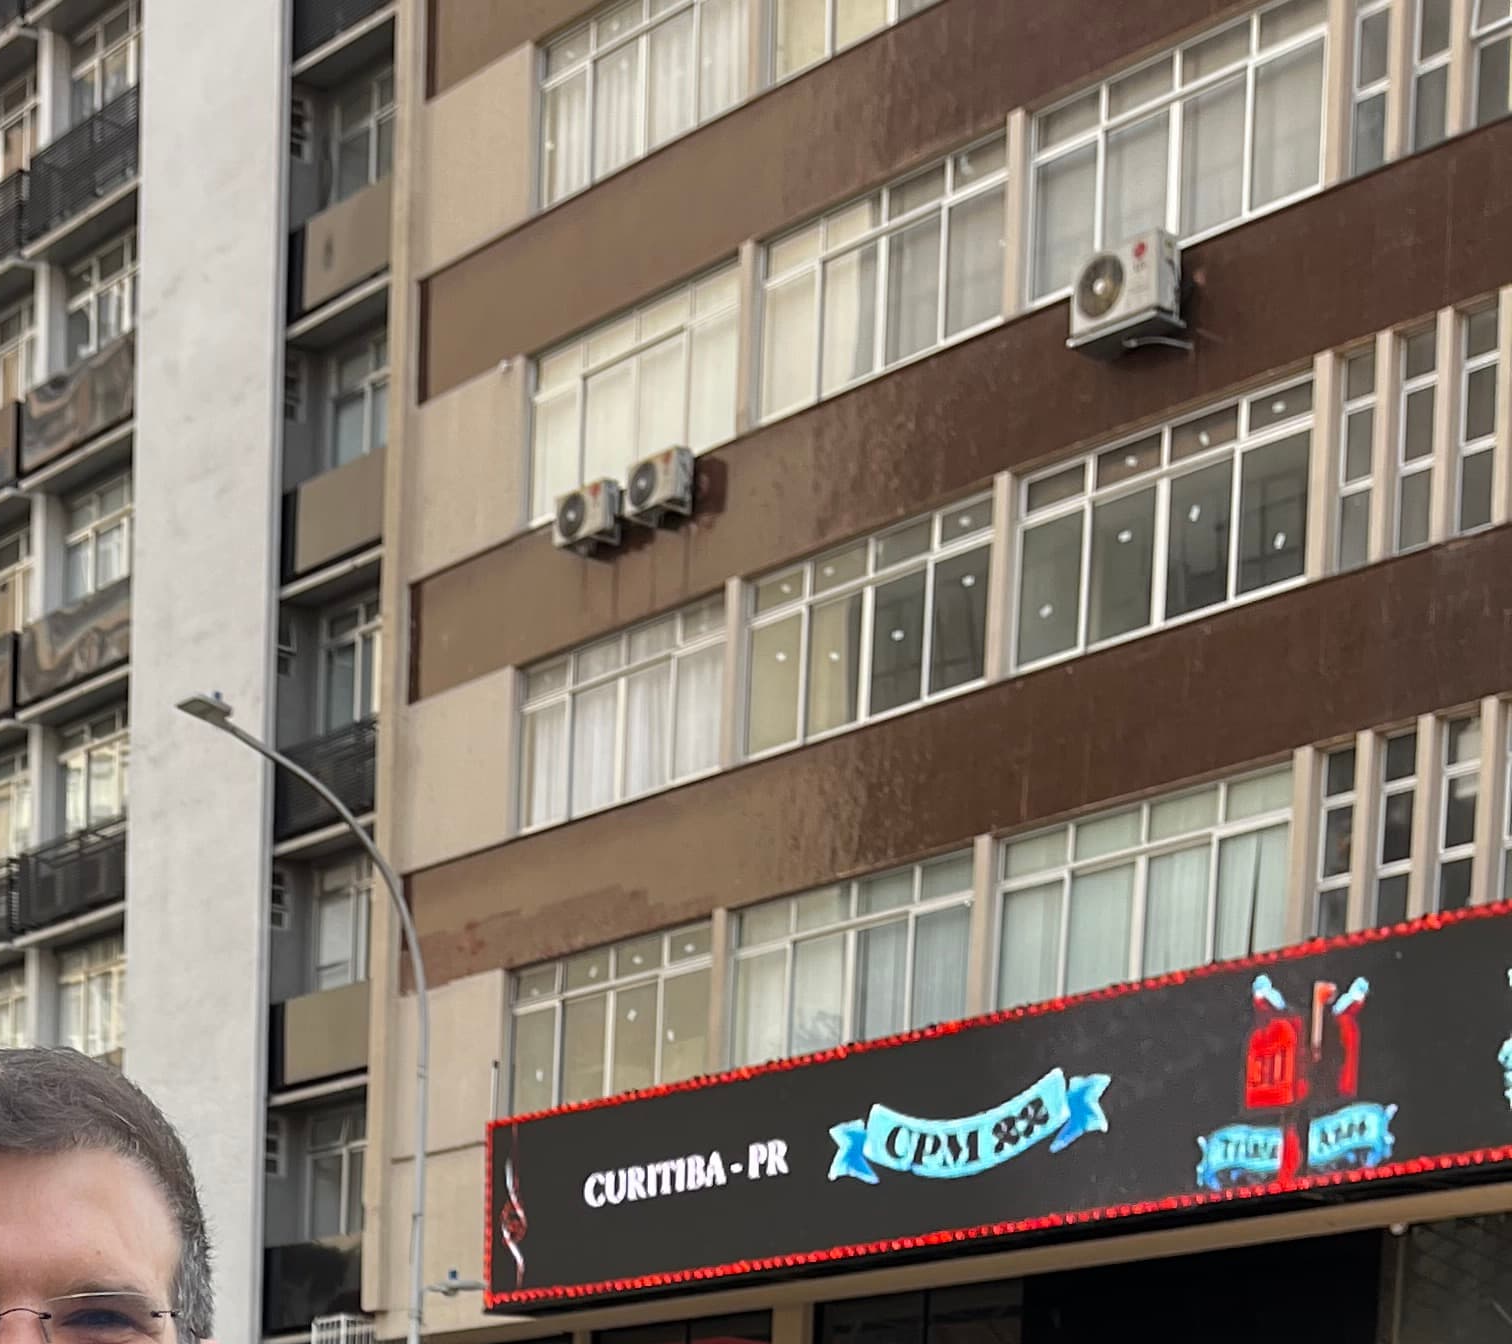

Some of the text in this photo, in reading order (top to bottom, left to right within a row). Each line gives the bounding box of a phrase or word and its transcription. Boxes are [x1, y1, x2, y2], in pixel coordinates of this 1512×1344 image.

[583, 1150, 727, 1208] CURITIBA
[747, 1138, 789, 1180] PR
[885, 1125, 979, 1167] CPM
